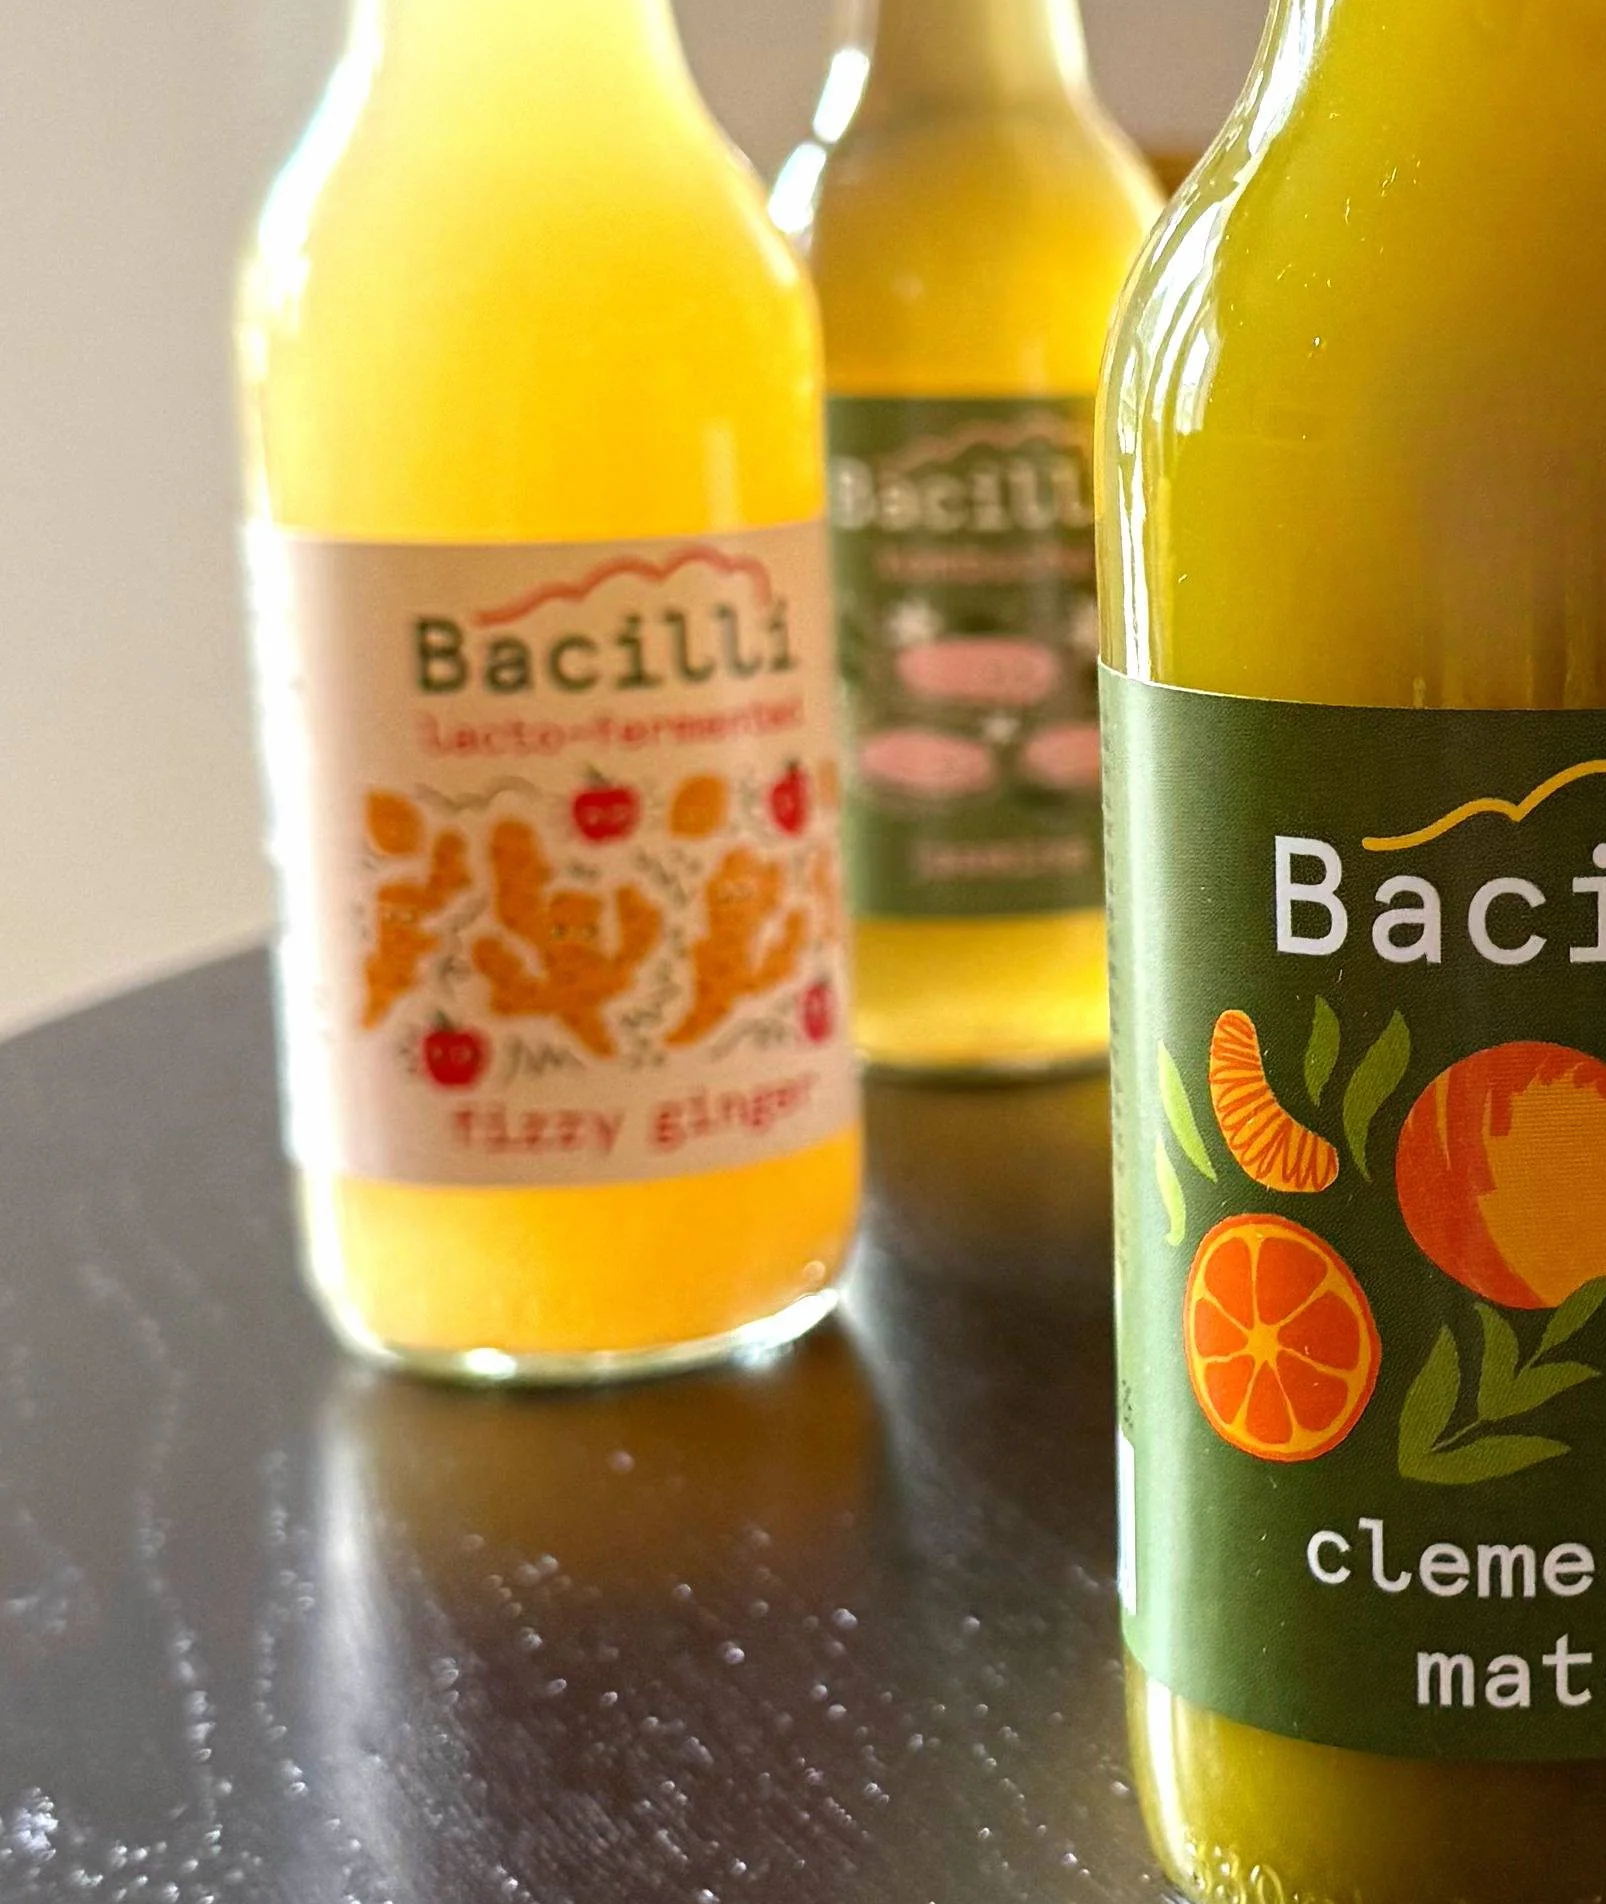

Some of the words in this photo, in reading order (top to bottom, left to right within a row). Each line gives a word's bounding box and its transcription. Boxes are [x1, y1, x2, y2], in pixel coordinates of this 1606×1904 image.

[830, 453, 1094, 532] Bacill
[414, 599, 797, 694] Bacilli
[453, 1099, 626, 1158] fizzy
[648, 1071, 821, 1153] ginger
